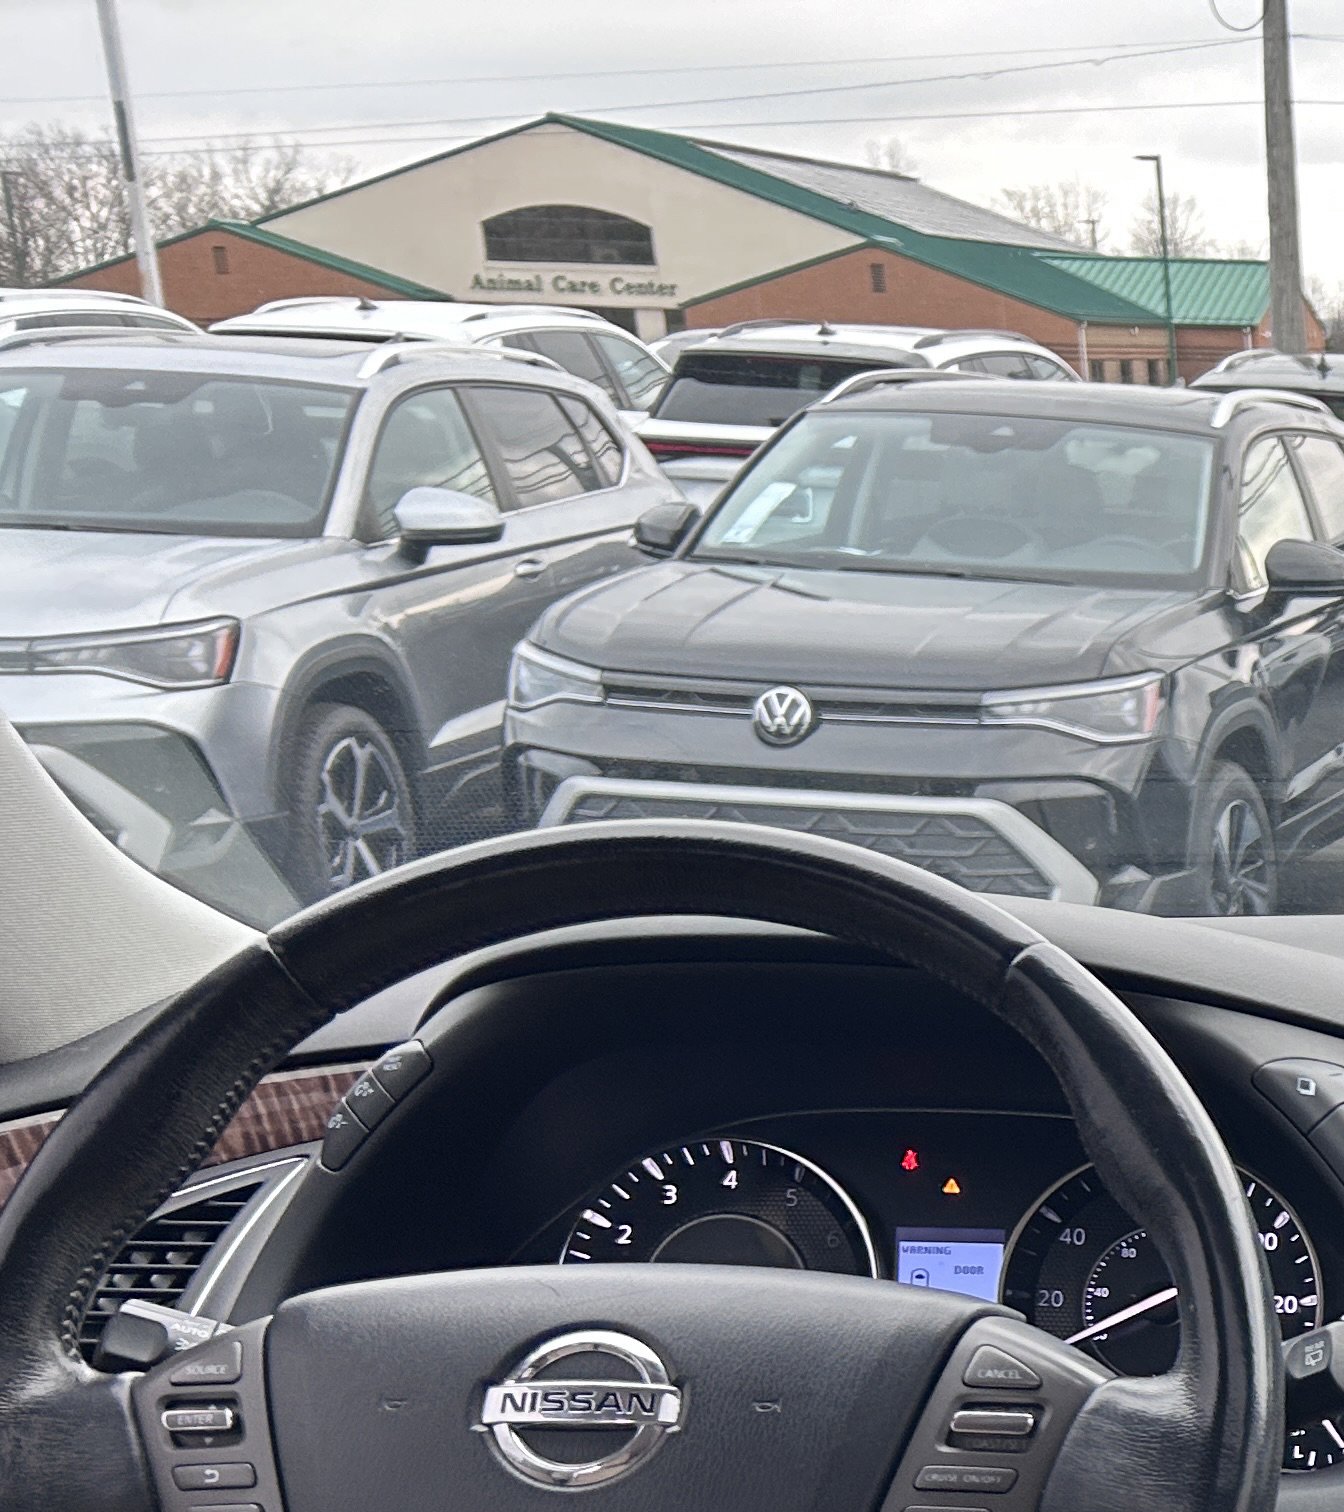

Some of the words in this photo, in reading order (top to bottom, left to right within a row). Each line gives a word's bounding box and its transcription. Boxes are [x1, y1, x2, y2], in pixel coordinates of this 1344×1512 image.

[470, 274, 543, 292] Animal
[552, 275, 600, 294] Care
[609, 276, 678, 296] Center
[721, 1169, 739, 1189] 4
[662, 1184, 678, 1205] 3
[786, 1188, 799, 1208] 5
[614, 1224, 632, 1245] 2
[826, 1231, 840, 1248] 6
[1059, 1227, 1086, 1246] 40
[902, 1245, 952, 1256] WARNING
[1120, 1247, 1137, 1259] 80
[1038, 1289, 1064, 1308] 20
[1092, 1287, 1110, 1298] 40
[171, 1322, 210, 1338] AUTO
[977, 1368, 1023, 1380] CANCEL
[500, 1391, 657, 1416] NISSAN
[176, 1413, 214, 1425] ENTER
[1293, 1445, 1304, 1459] L
